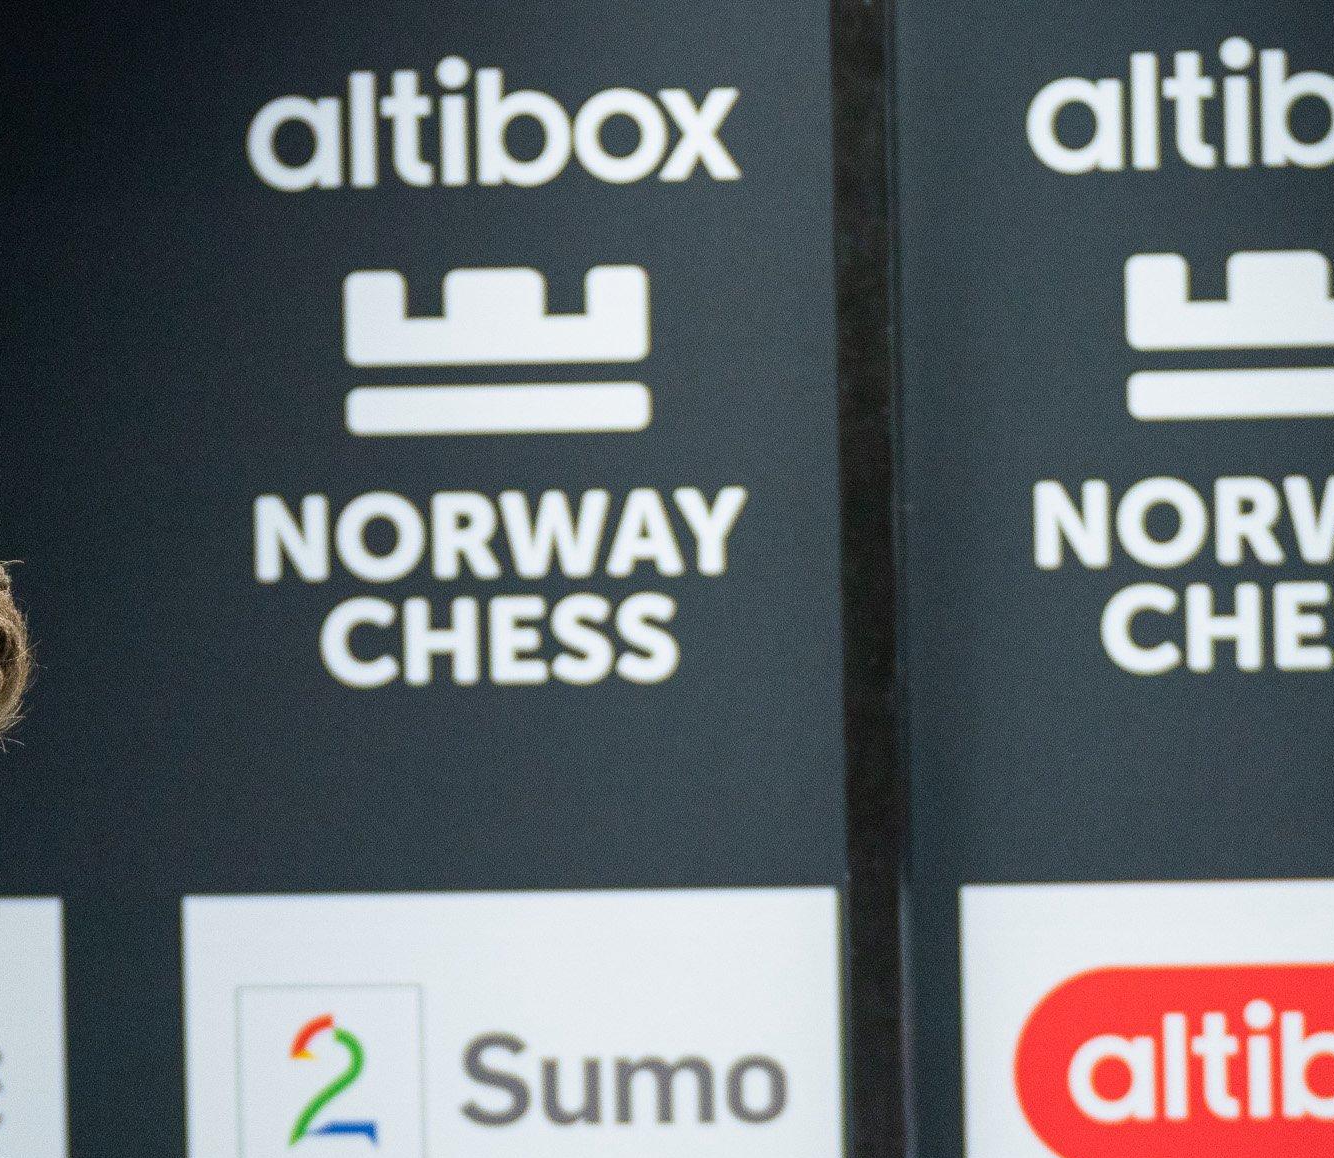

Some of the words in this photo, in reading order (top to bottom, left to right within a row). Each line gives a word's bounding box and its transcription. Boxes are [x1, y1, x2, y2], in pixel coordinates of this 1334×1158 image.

[247, 55, 742, 191] altibox
[254, 486, 747, 583] NORWAY
[320, 592, 680, 687] CHESS
[460, 1031, 789, 1128] Sumo
